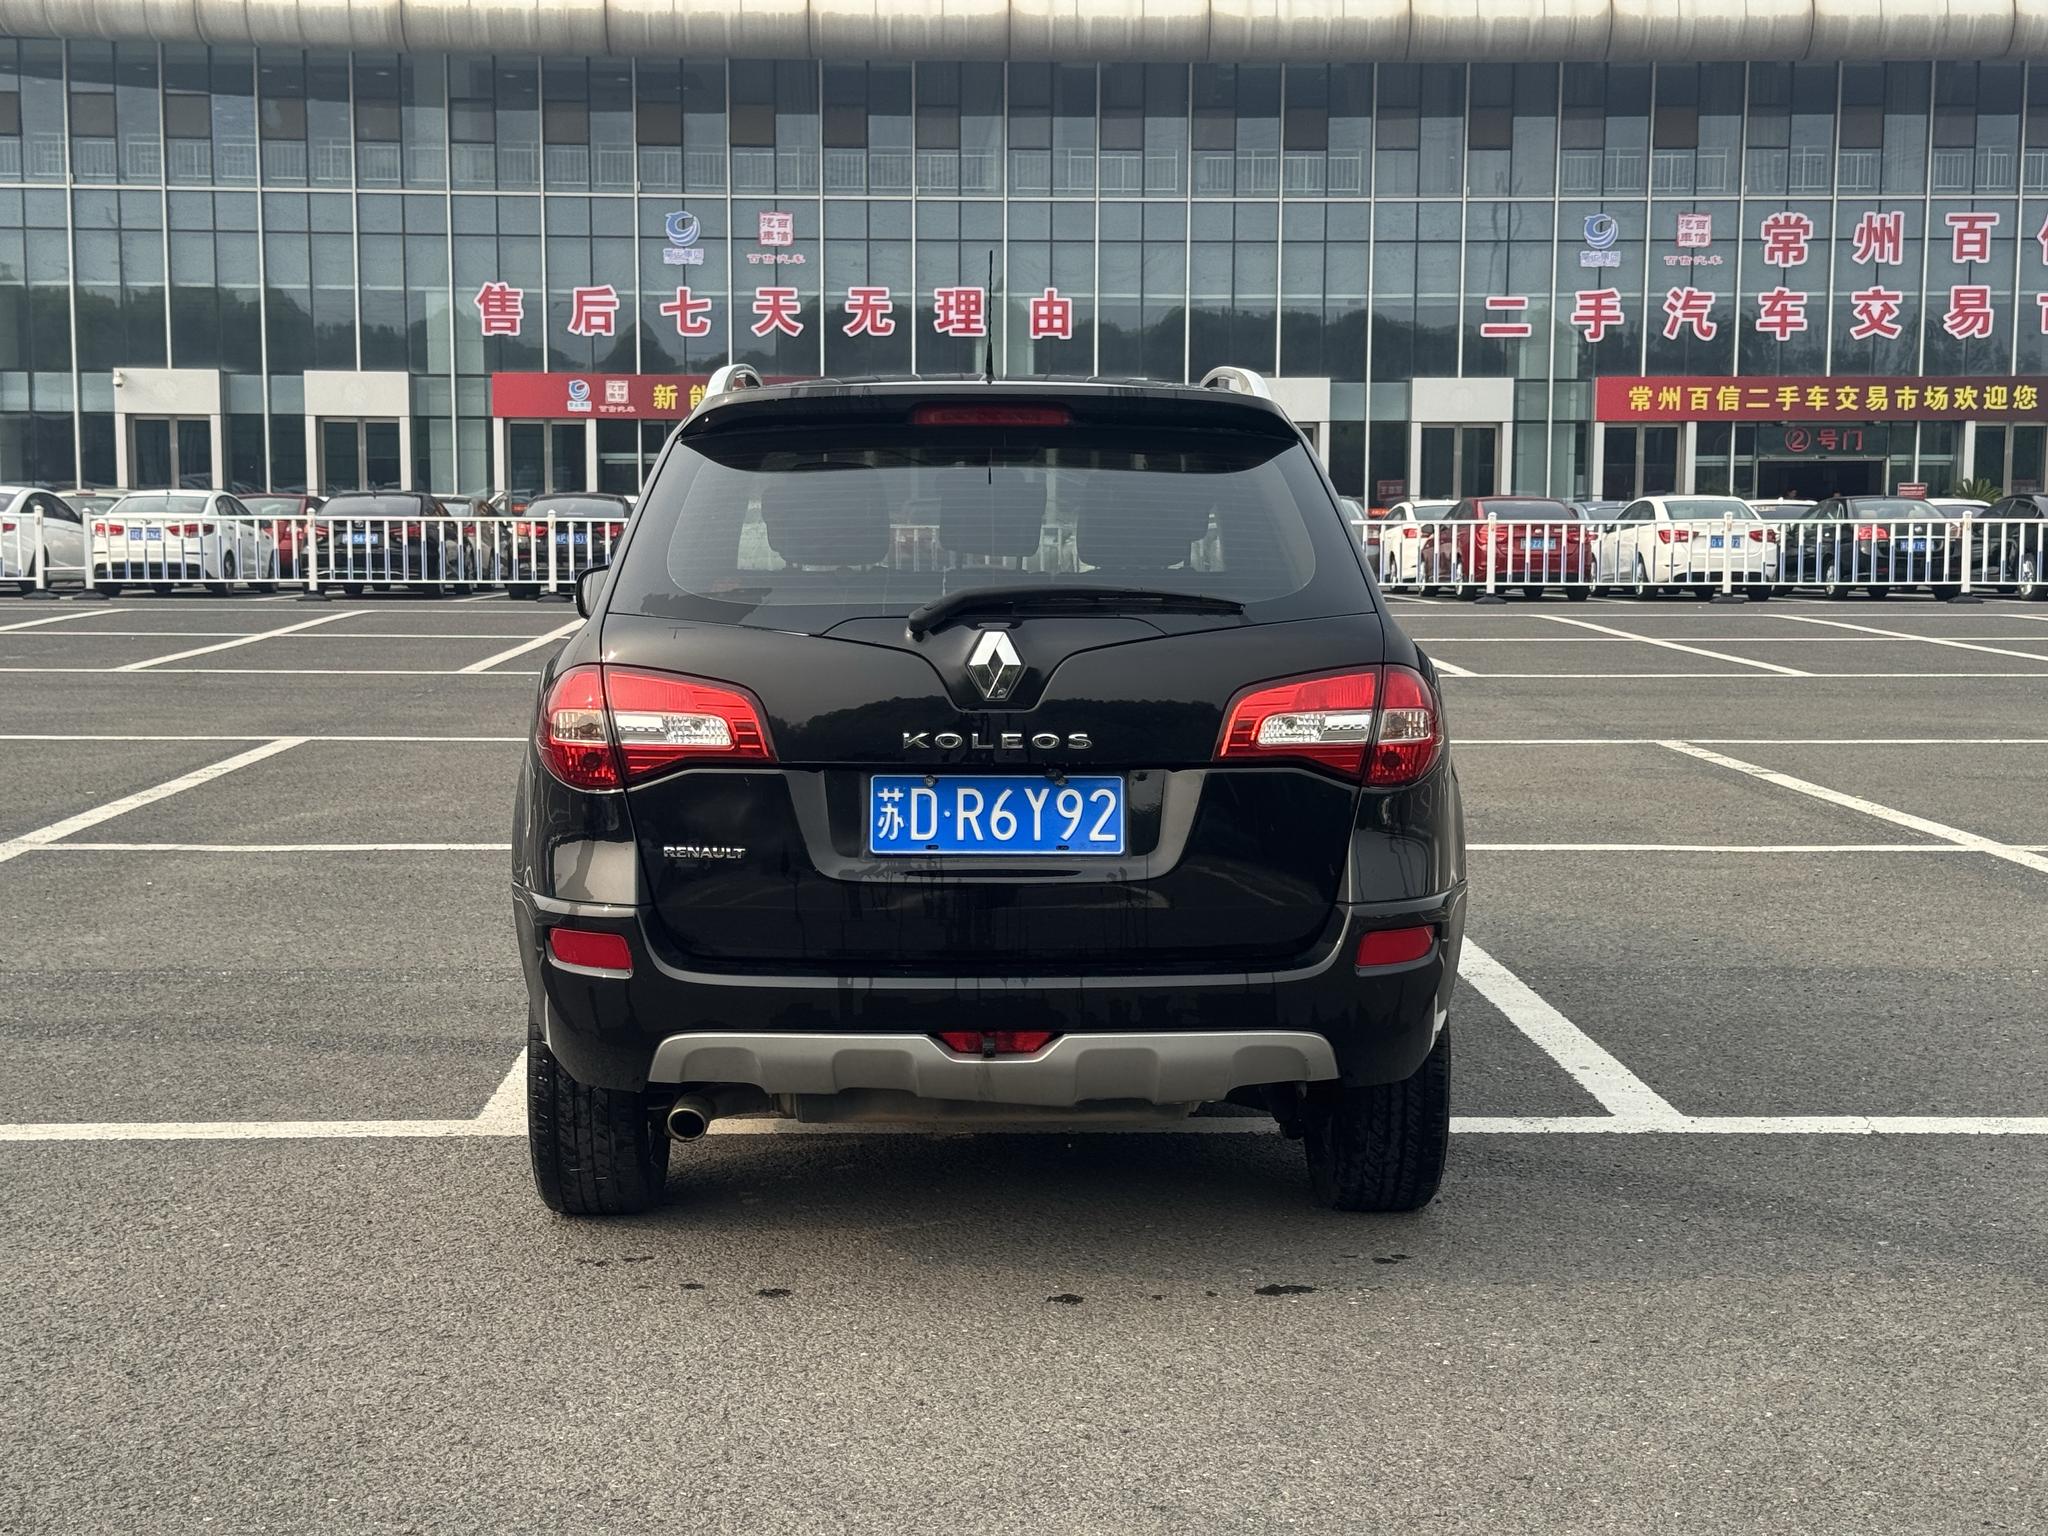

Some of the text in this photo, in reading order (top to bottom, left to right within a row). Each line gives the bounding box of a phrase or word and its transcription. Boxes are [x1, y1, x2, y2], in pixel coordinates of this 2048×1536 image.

[1763, 213, 2048, 264] 常州百
[475, 283, 1073, 339] 售后七天无理由
[1481, 286, 2048, 341] 二手汽车交易
[1629, 384, 2038, 411] 常州百信二手车交易市场欢迎您
[903, 733, 1092, 749] KOLEOS
[878, 788, 1117, 841] 苏D·R6Y92
[663, 846, 746, 859] RENAULT
